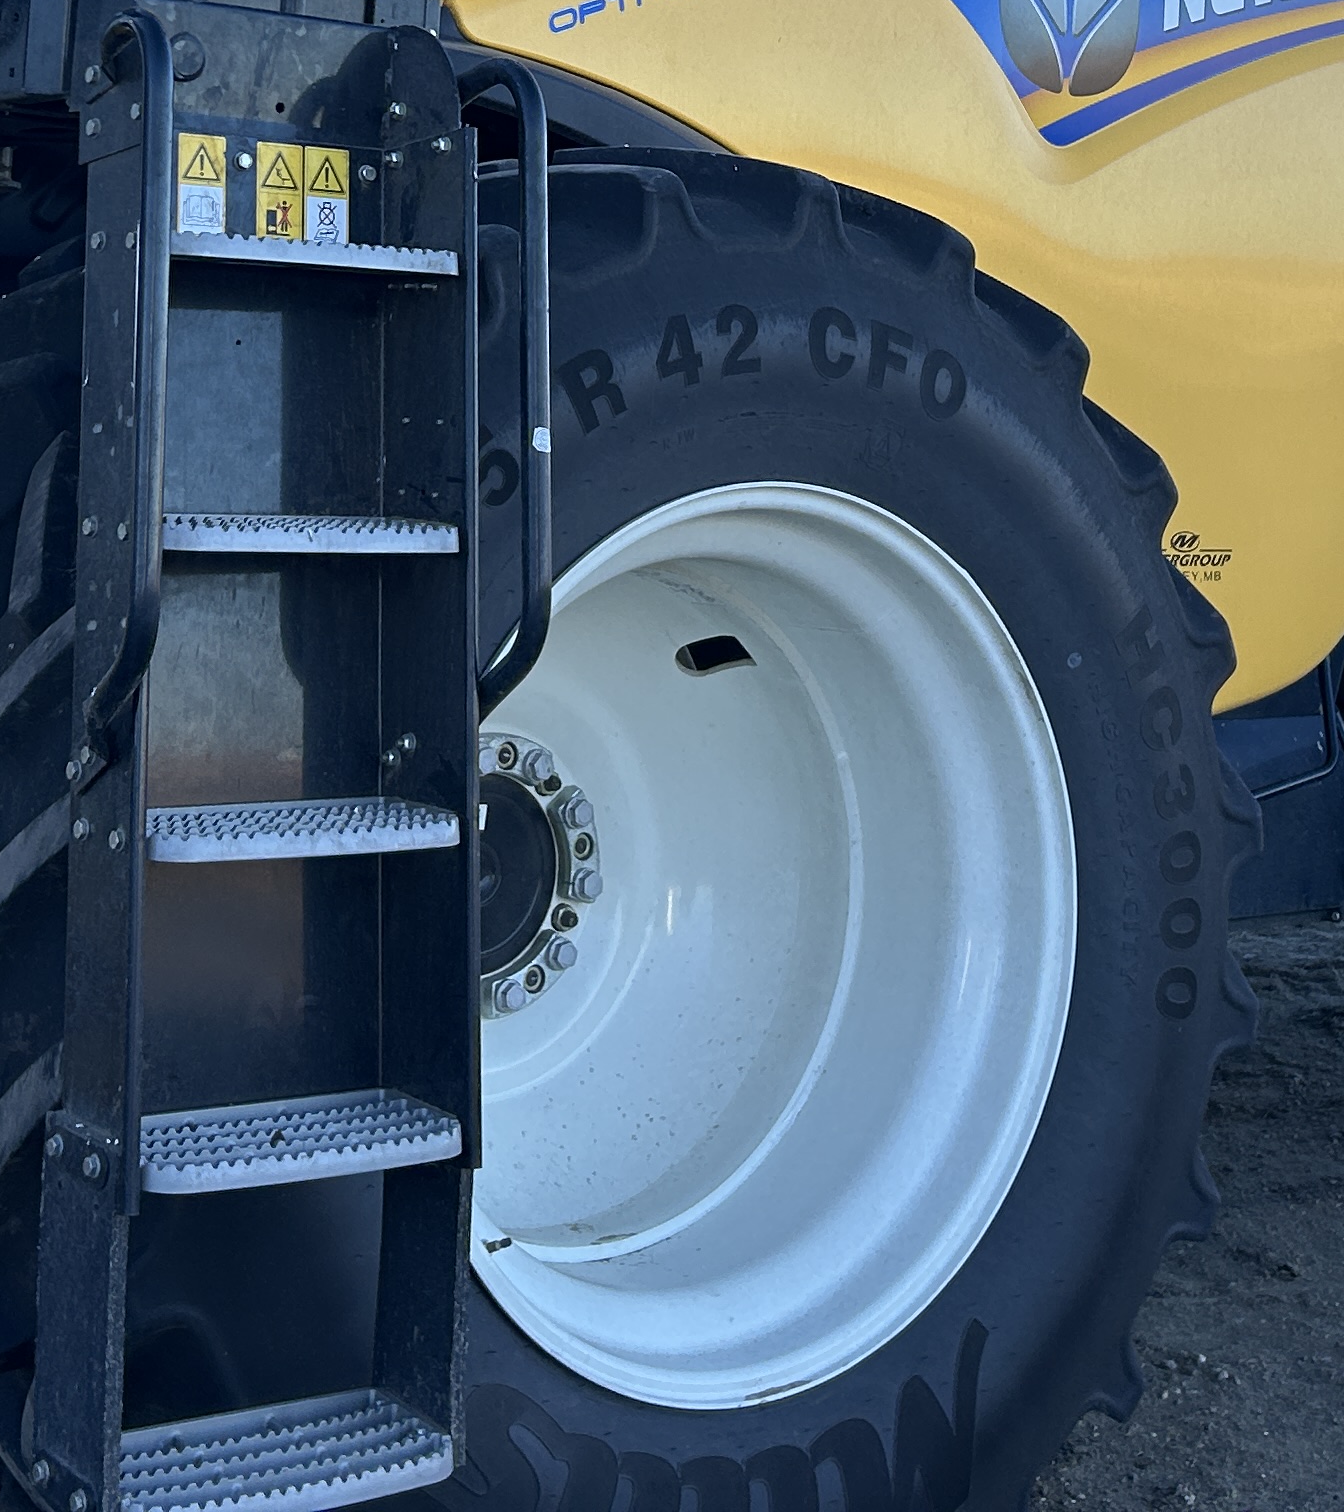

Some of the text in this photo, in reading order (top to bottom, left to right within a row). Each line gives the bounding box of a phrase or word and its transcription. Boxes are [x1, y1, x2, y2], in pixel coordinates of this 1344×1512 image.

[555, 304, 967, 436] R 42 CFO
[1164, 553, 1232, 567] RGROUP
